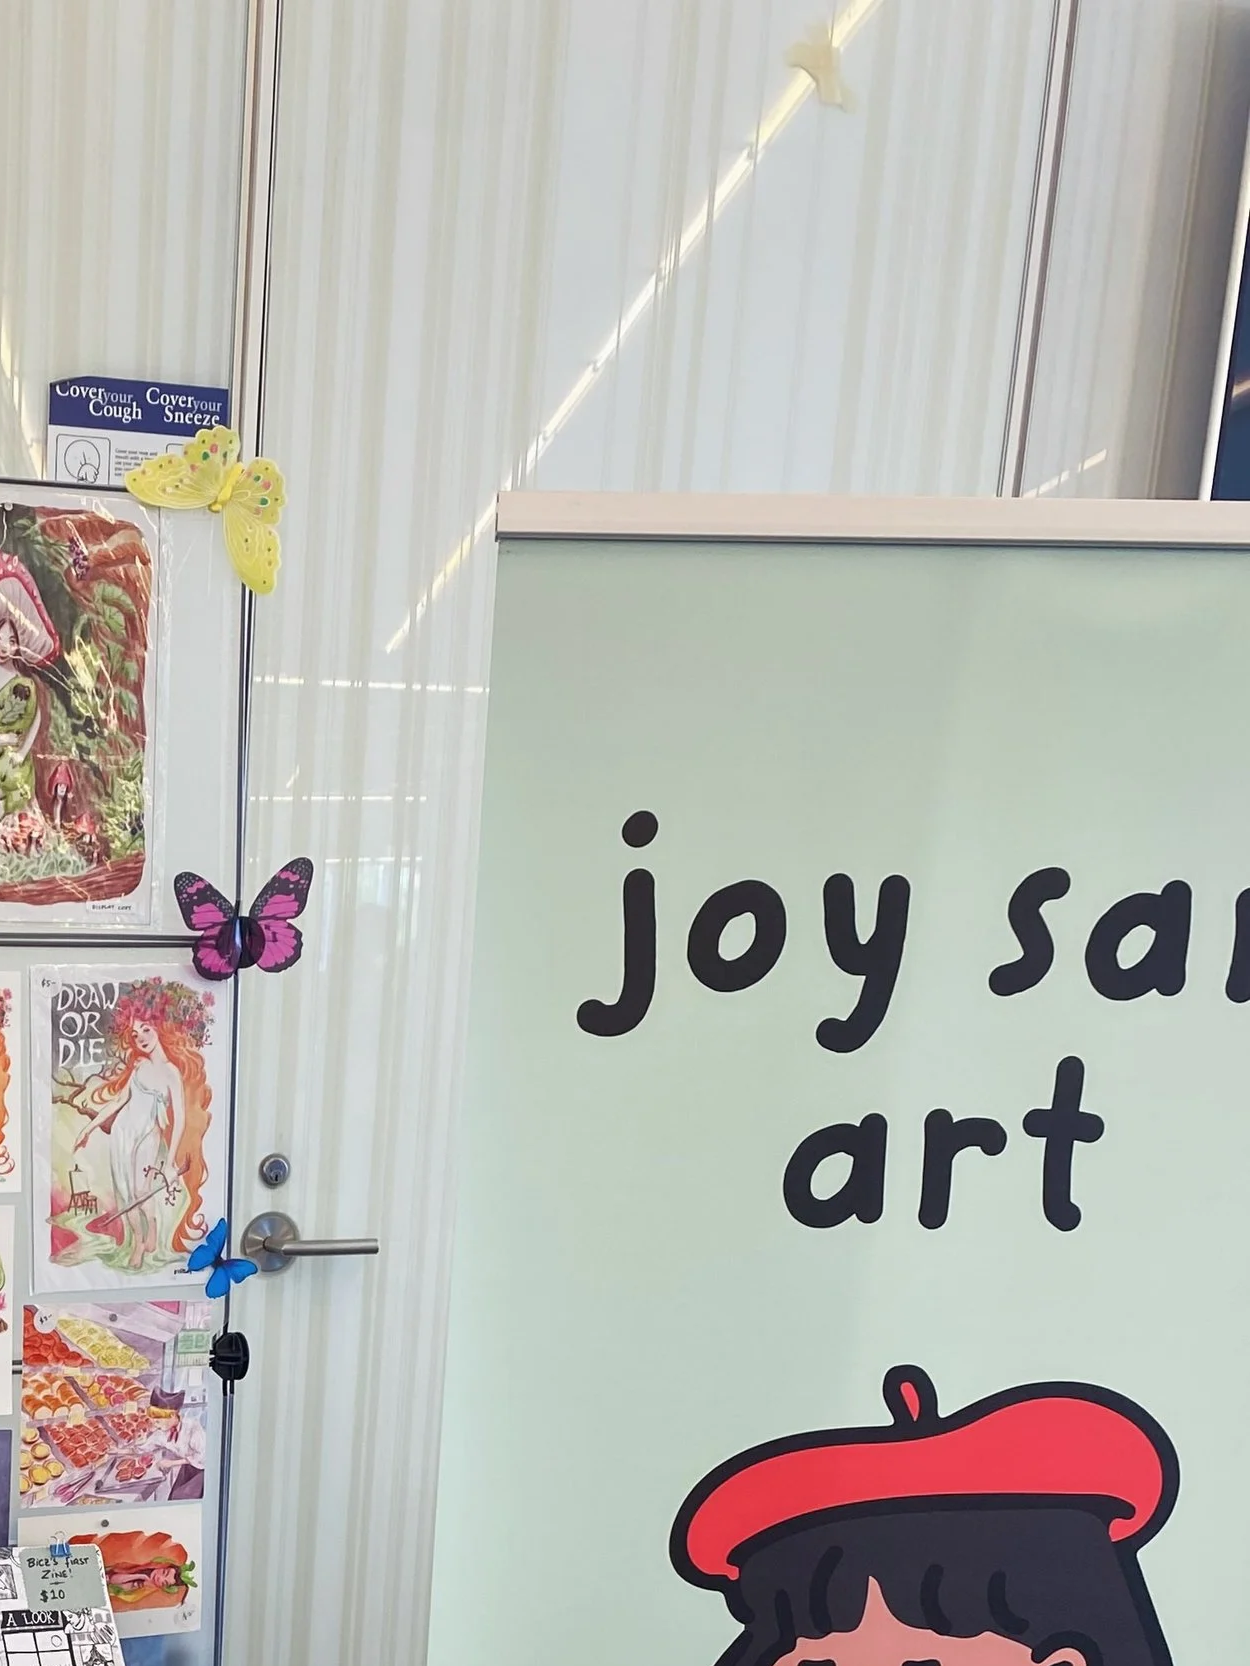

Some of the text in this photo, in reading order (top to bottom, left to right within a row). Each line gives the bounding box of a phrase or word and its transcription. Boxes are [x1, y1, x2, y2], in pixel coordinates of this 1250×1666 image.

[55, 383, 134, 405] Cover your
[146, 387, 222, 413] Cover your
[89, 399, 142, 423] Cough
[163, 404, 220, 426] Sneeze
[576, 810, 912, 1054] joy
[56, 982, 120, 1010] DRAW
[59, 1010, 100, 1037] OR
[58, 1037, 105, 1067] DIE
[783, 1055, 1105, 1231] art
[39, 1589, 66, 1603] $10
[5, 1610, 56, 1626] A LOOK
